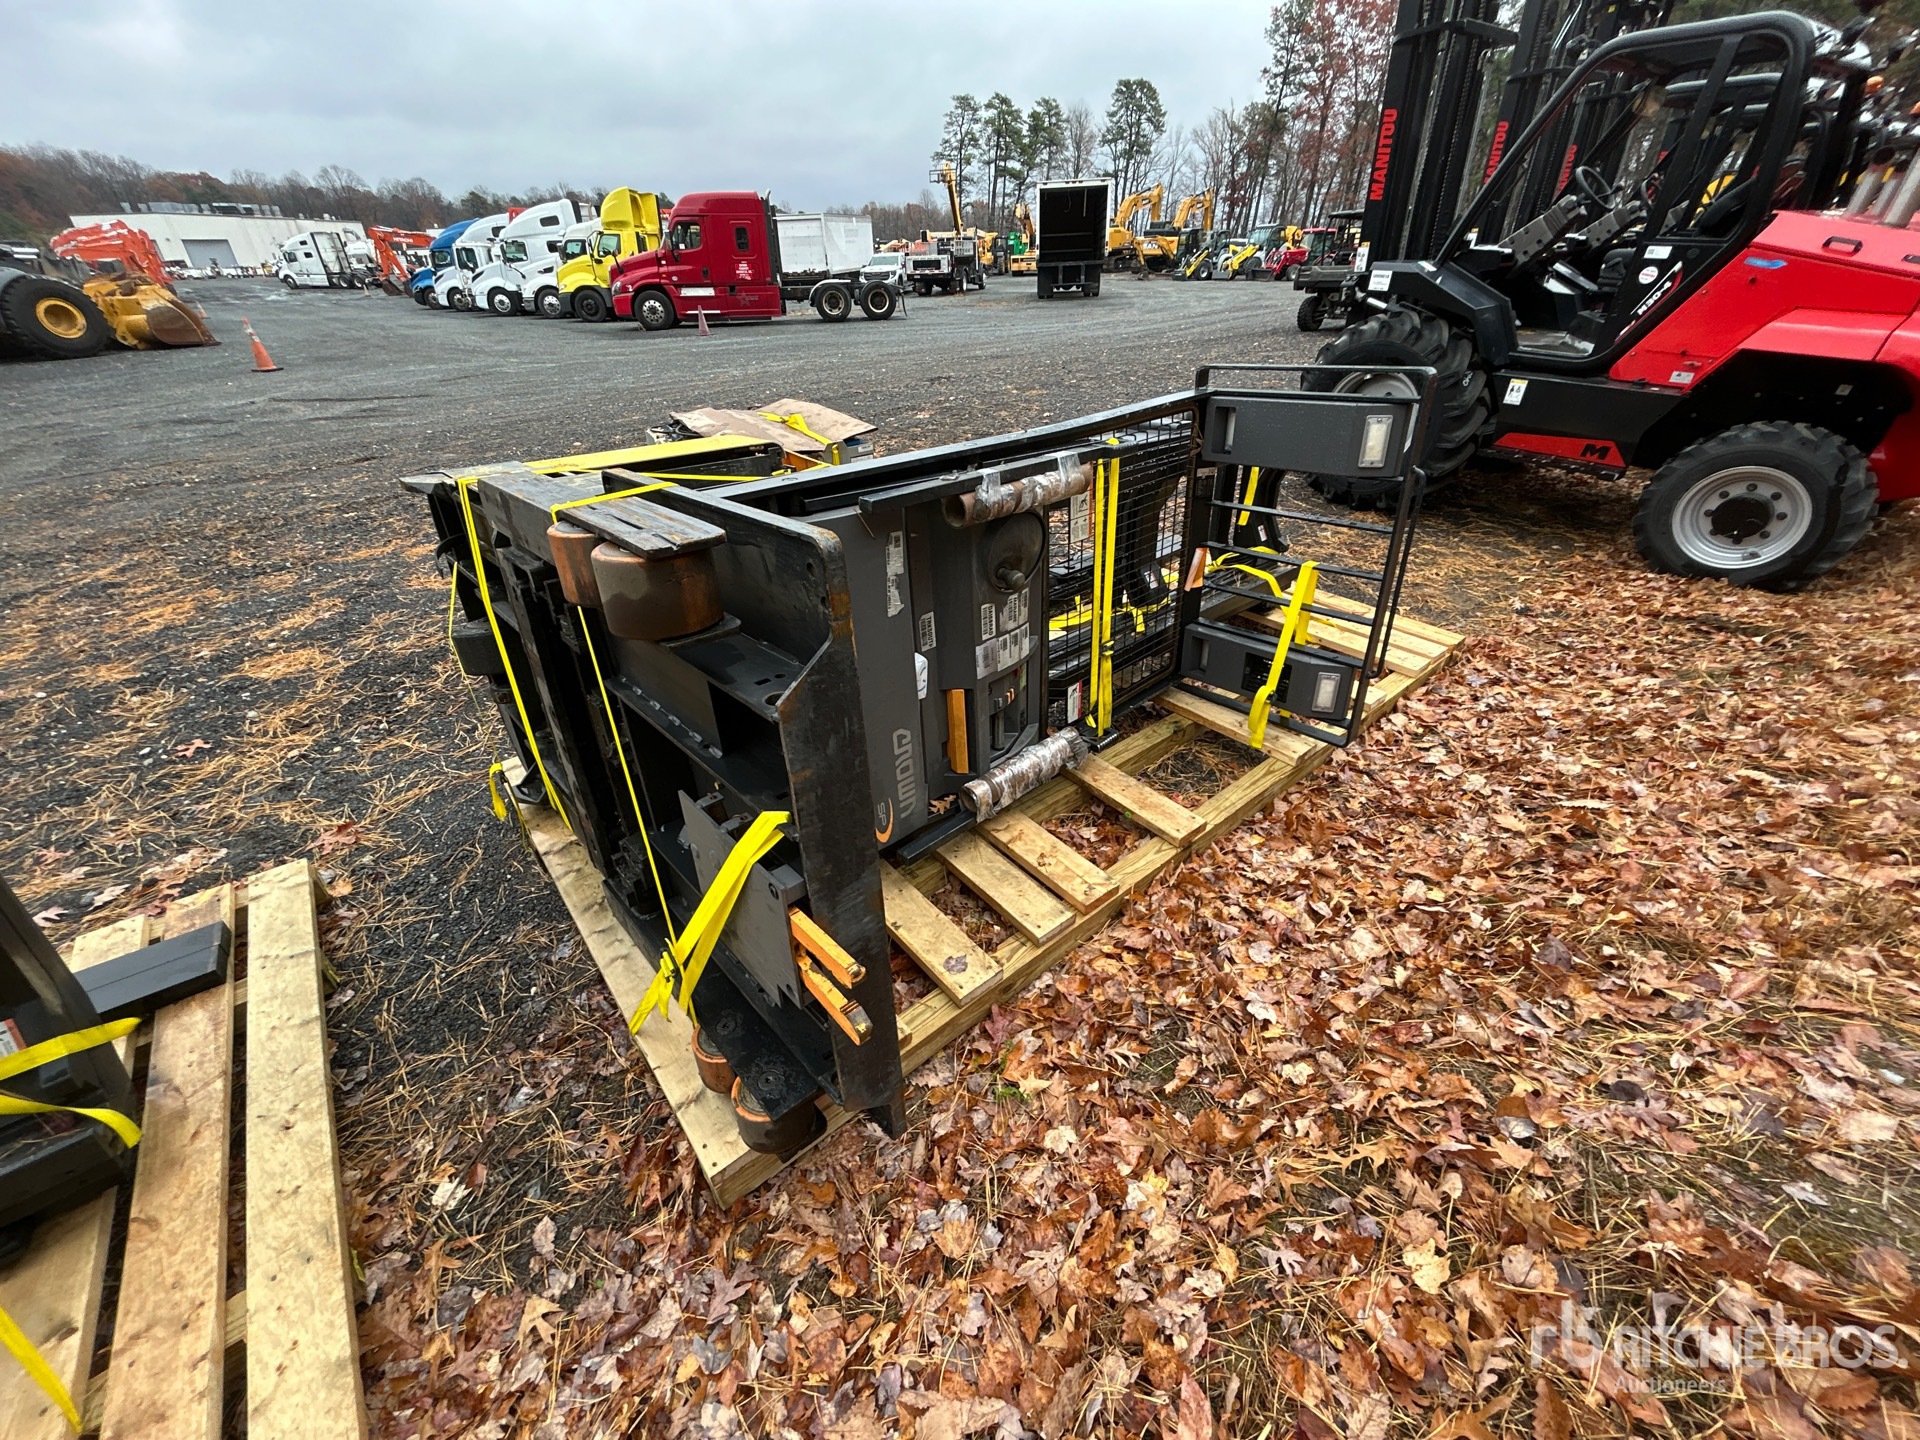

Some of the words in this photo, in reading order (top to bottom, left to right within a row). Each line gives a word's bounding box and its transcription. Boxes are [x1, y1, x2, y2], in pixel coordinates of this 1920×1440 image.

[1370, 109, 1397, 200] MANITOU
[878, 803, 887, 826] SP
[893, 729, 916, 818] CROWN
